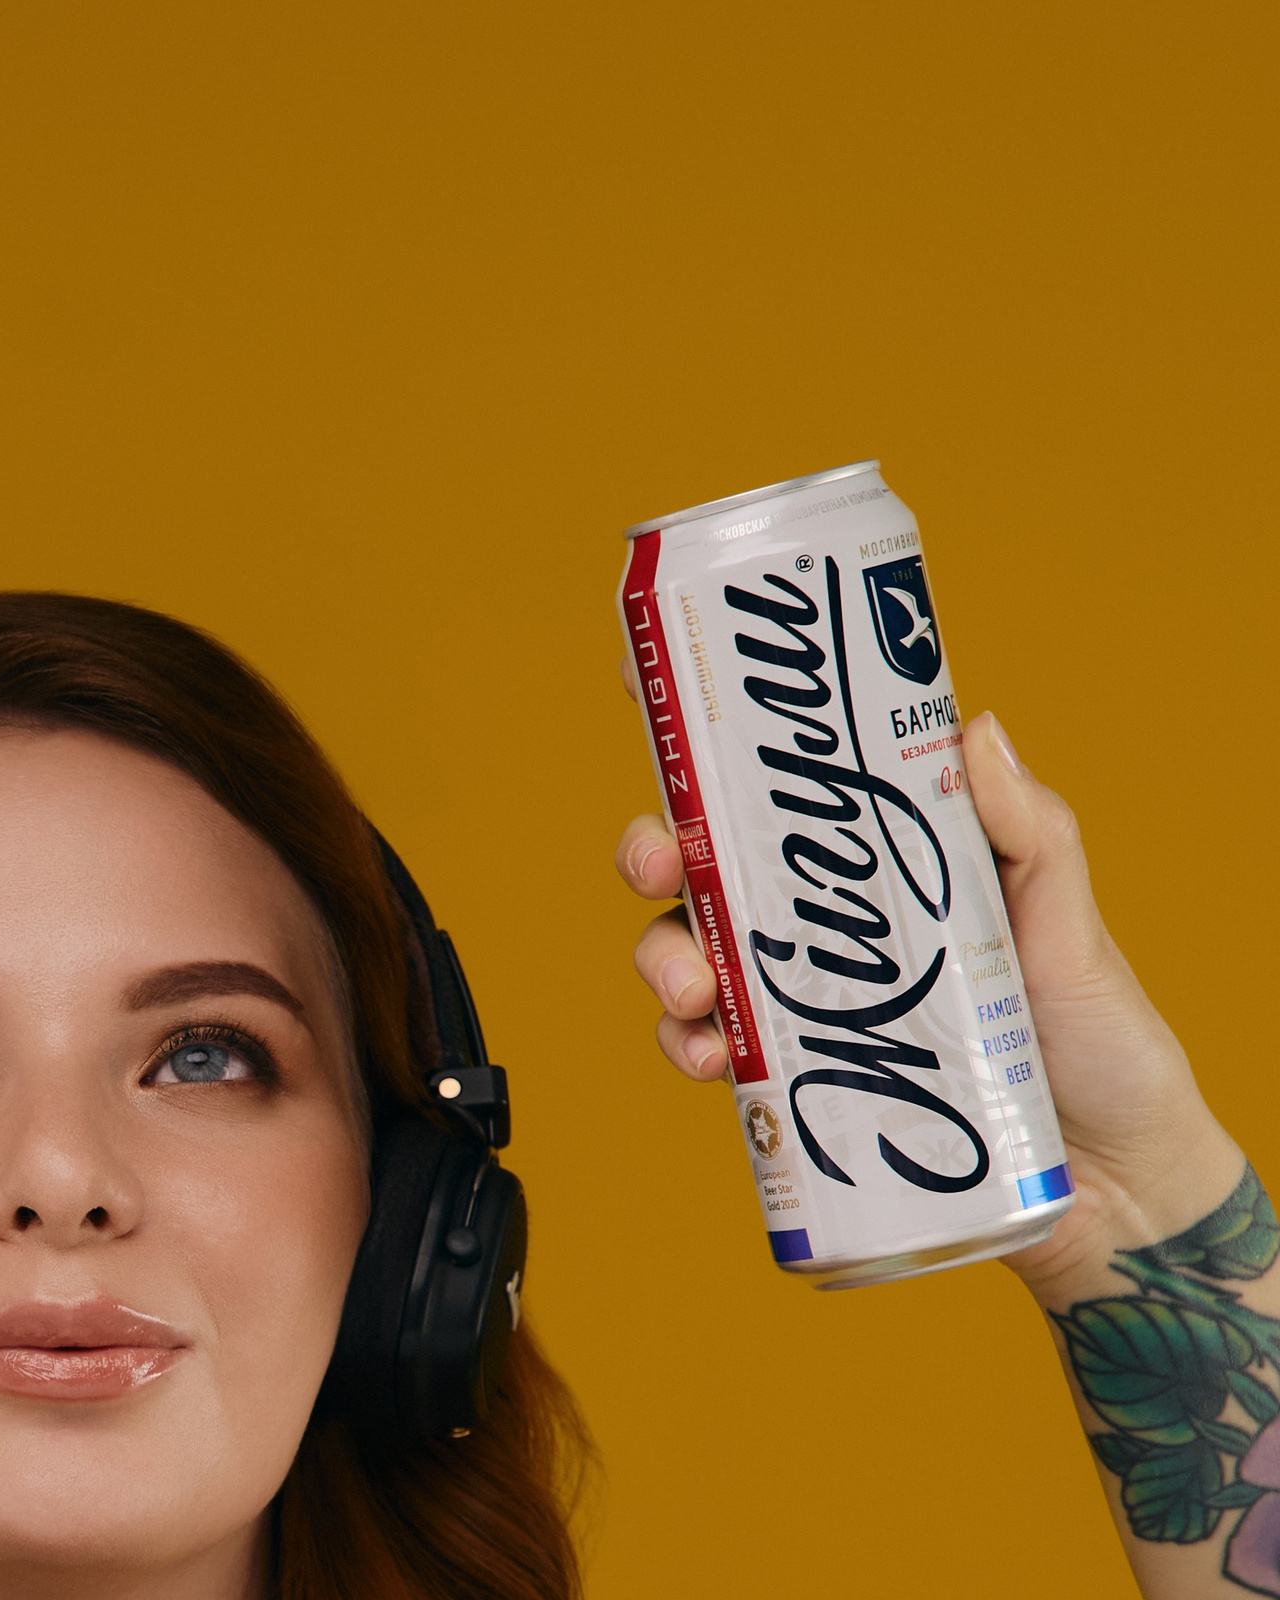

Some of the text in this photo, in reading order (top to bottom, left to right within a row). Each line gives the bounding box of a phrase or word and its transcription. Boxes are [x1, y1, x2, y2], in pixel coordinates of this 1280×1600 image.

[680, 594, 722, 723] ВЫСШИЙ СОРТ
[628, 590, 689, 794] ZHIGULI
[940, 766, 962, 795] 0.0
[678, 823, 707, 840] ALCOHOL
[682, 838, 713, 864] FREE
[724, 555, 991, 1194] Жигули
[700, 892, 749, 1058] БЕЗАЛКОГОЛЬНОЕ
[972, 958, 1012, 988] quality
[977, 993, 1022, 1024] FAMOUS
[983, 1025, 1031, 1058] RUSSIAN
[1005, 1061, 1034, 1086] BEER
[760, 1168, 791, 1181] European
[764, 1183, 793, 1196] Beer Star
[767, 1198, 800, 1212] Gold 2020
